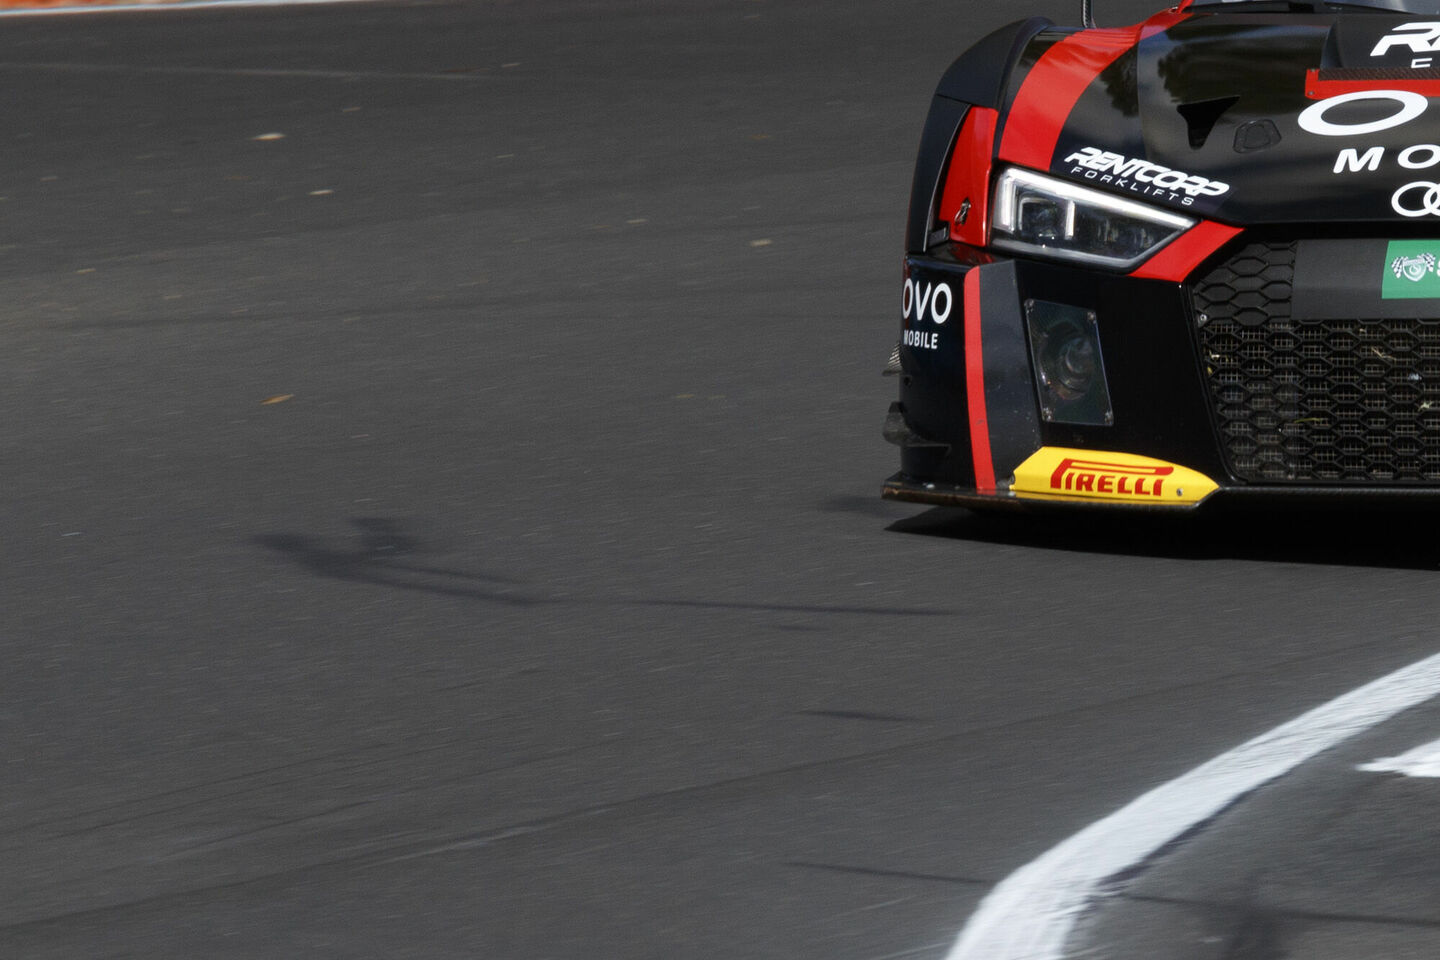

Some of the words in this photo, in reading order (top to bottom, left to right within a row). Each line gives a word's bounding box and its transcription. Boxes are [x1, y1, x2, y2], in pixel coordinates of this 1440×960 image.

[1064, 146, 1230, 197] RENTCORP
[1070, 166, 1195, 206] FORKLIFTS
[902, 278, 953, 324] OVO
[903, 329, 939, 350] MOBILE
[1050, 458, 1174, 497] PIRELLI
